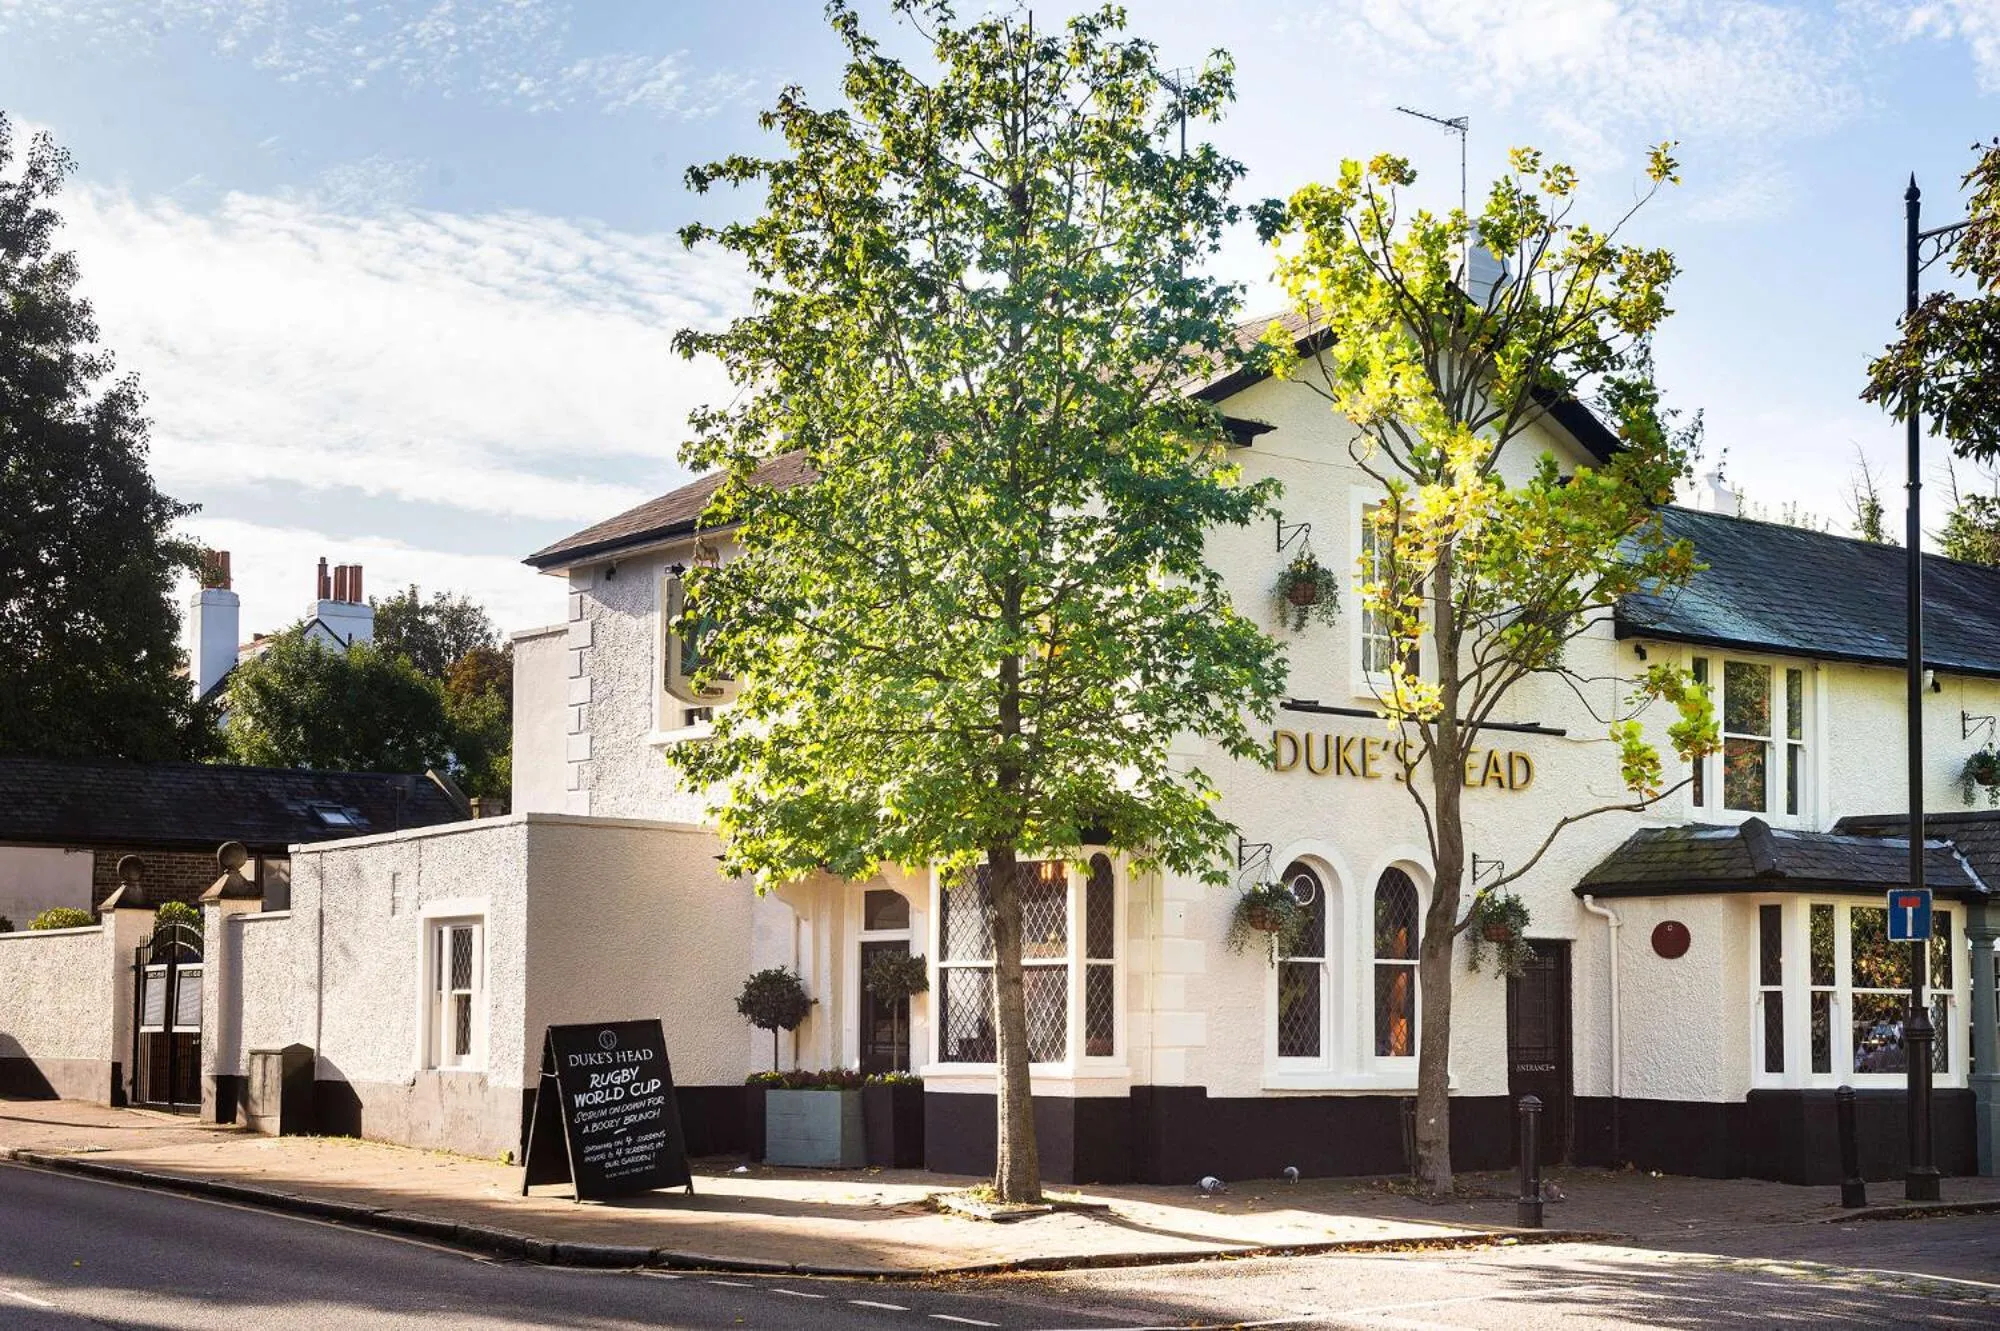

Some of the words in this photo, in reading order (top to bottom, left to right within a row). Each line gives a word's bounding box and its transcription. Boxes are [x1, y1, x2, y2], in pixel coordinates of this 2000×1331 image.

[1273, 728, 1417, 782] DUKE'S
[1462, 748, 1536, 790] EAD
[568, 1052, 613, 1067] DUKE'S
[616, 1049, 653, 1063] HEAD
[589, 1066, 640, 1089] RUGBY
[574, 1087, 625, 1108] WORLD
[630, 1078, 661, 1097] CUP
[574, 1108, 607, 1124] SCRUM
[608, 1105, 620, 1115] ON
[620, 1100, 646, 1113] DOWN
[647, 1096, 665, 1106] FOR
[582, 1125, 589, 1134] A
[591, 1117, 621, 1133] BOOZY
[623, 1108, 661, 1125] BRUNCH
[625, 1136, 632, 1145] 4
[604, 1160, 620, 1168] OUR
[615, 1148, 622, 1157] 4
